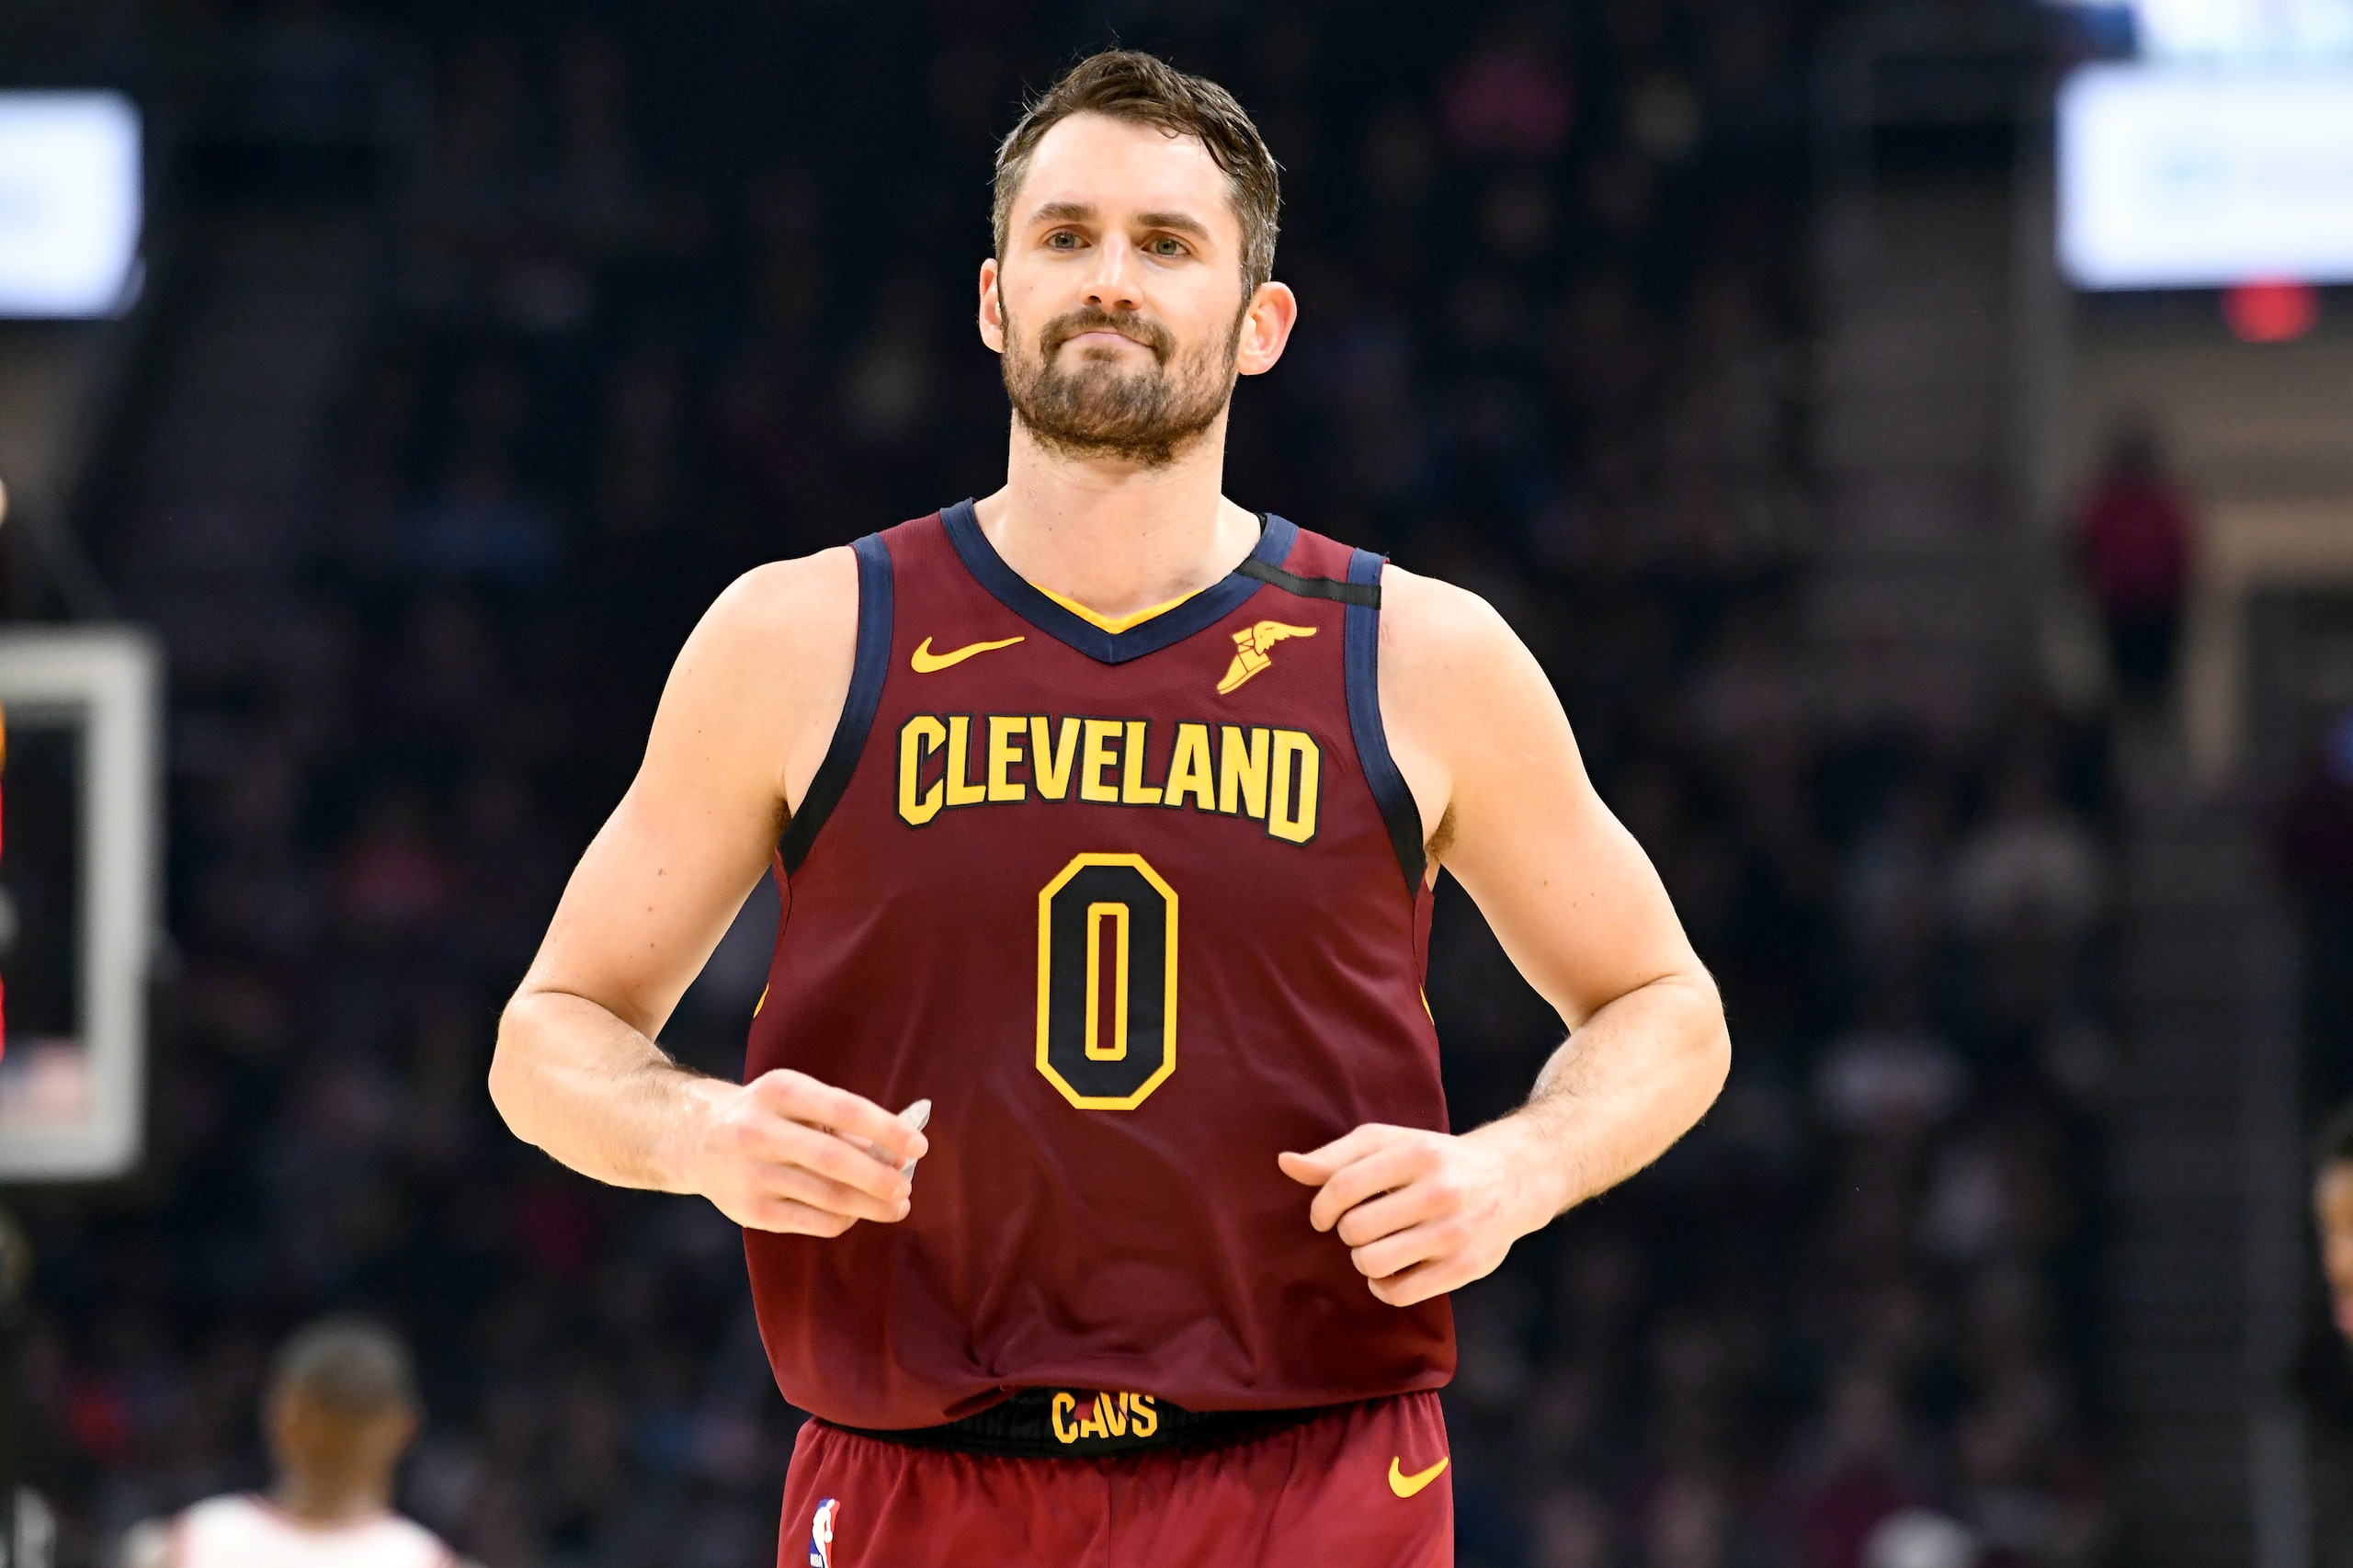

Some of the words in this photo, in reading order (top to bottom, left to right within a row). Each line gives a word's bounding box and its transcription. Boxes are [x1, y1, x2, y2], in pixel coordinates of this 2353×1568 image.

[896, 713, 1323, 846] CLEVELAND
[1035, 852, 1179, 1111] 0
[1051, 1392, 1158, 1444] CAVS
